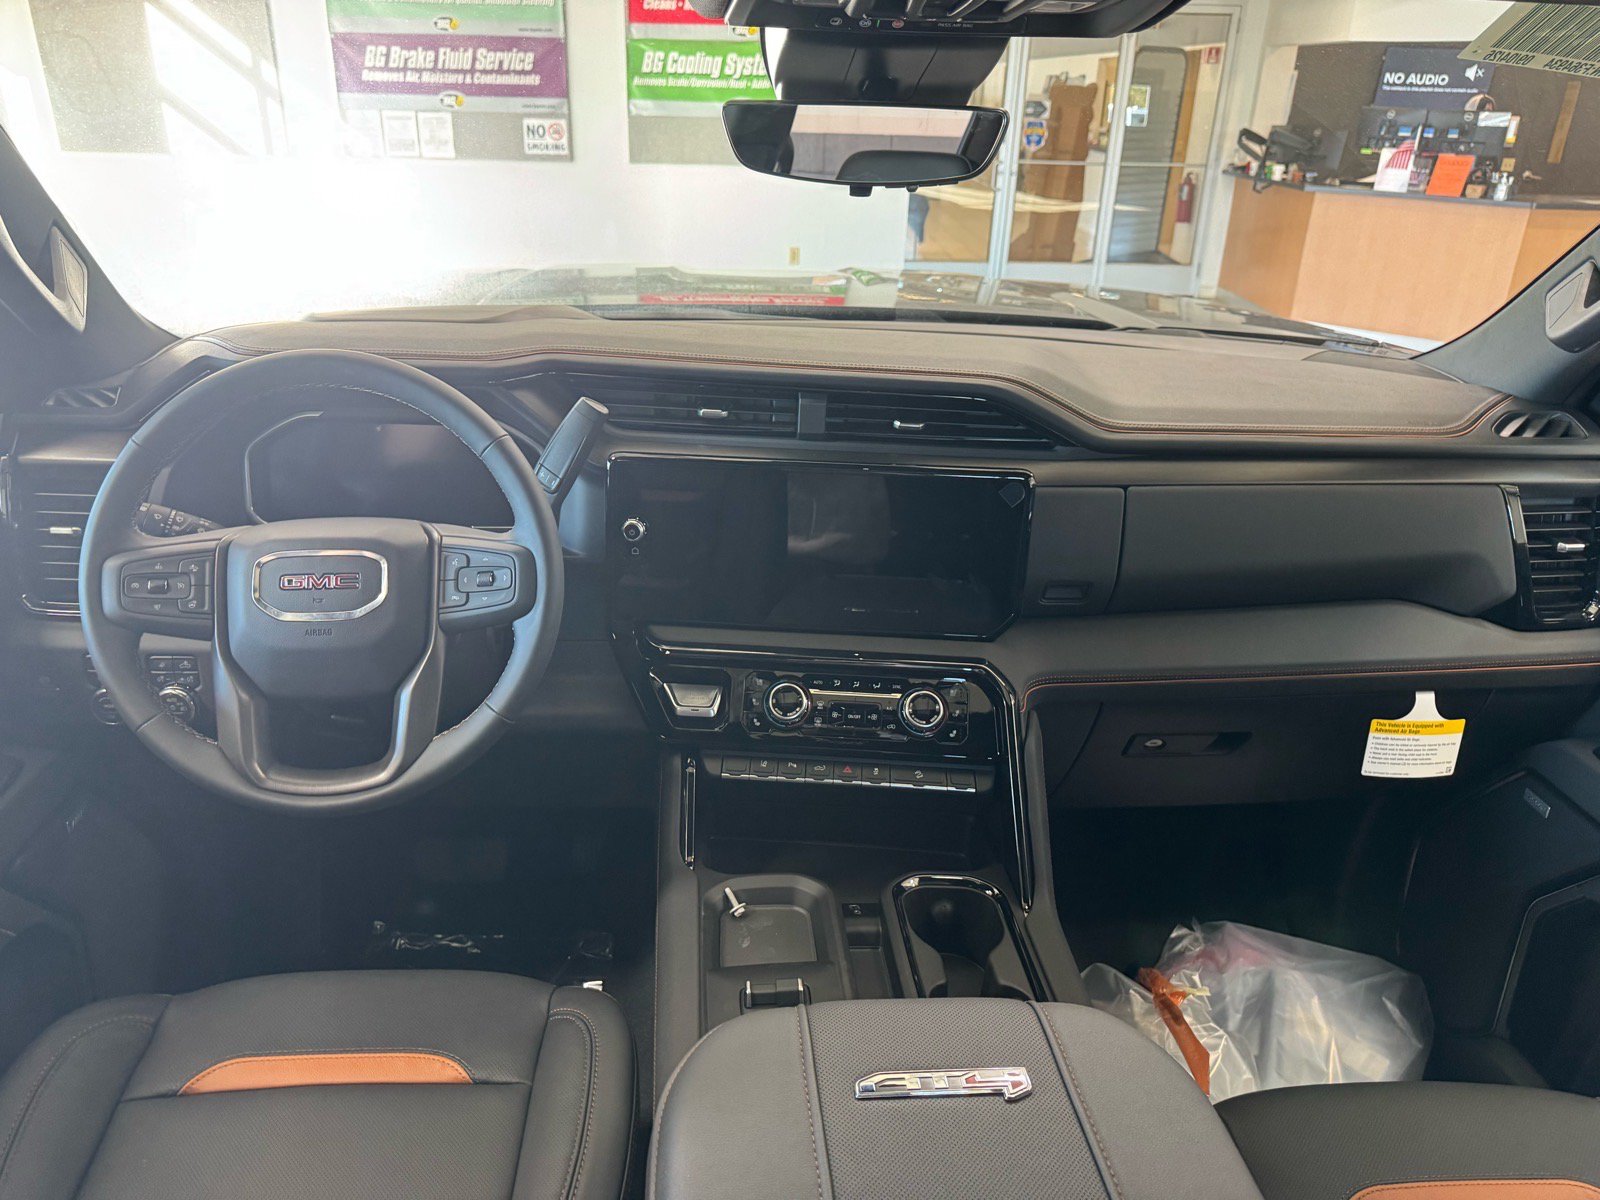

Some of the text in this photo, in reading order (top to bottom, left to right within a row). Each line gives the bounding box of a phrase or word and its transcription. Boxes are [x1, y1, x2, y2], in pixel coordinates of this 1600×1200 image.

[364, 45, 535, 71] BG Brake Fluid Service
[642, 50, 665, 74] BG
[666, 51, 723, 79] Cooling
[362, 69, 404, 82] Removes
[421, 71, 464, 84] Moisture
[473, 72, 541, 86] Contaminants
[1384, 72, 1449, 85] NO AUDIO
[527, 124, 546, 138] NO
[527, 143, 566, 151] SMOKING
[279, 573, 361, 590] GMC
[305, 628, 332, 636] AIRBAG
